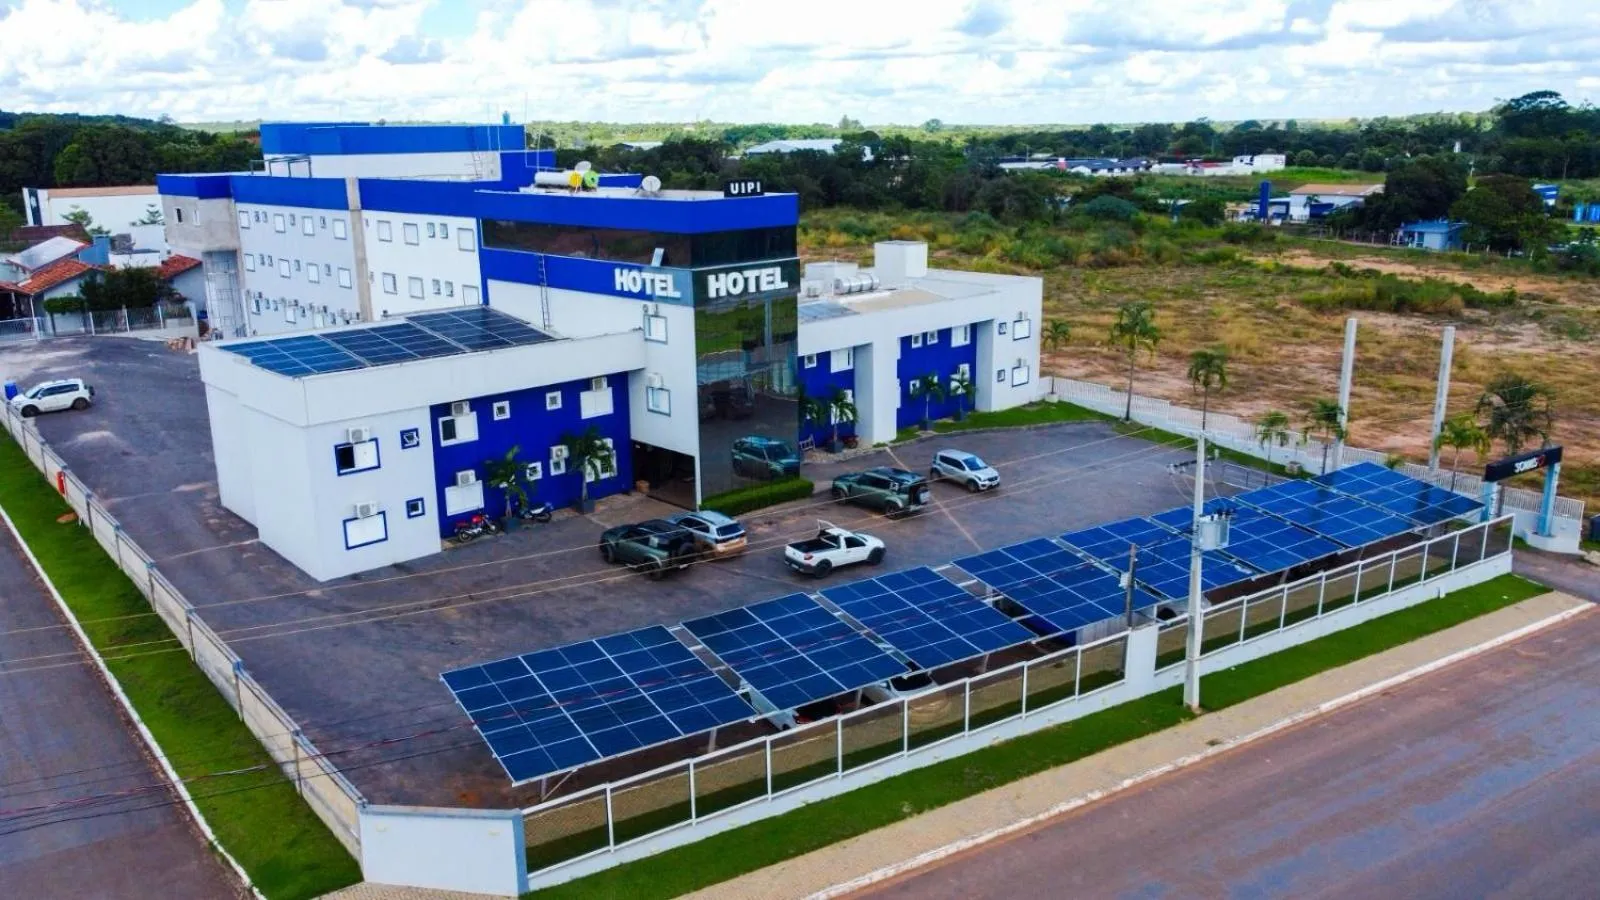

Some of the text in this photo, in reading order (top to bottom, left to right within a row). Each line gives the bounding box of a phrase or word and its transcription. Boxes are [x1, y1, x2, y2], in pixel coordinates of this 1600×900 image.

[730, 181, 761, 194] UIPI
[614, 268, 681, 298] HOTEL
[707, 266, 789, 298] HOTEL
